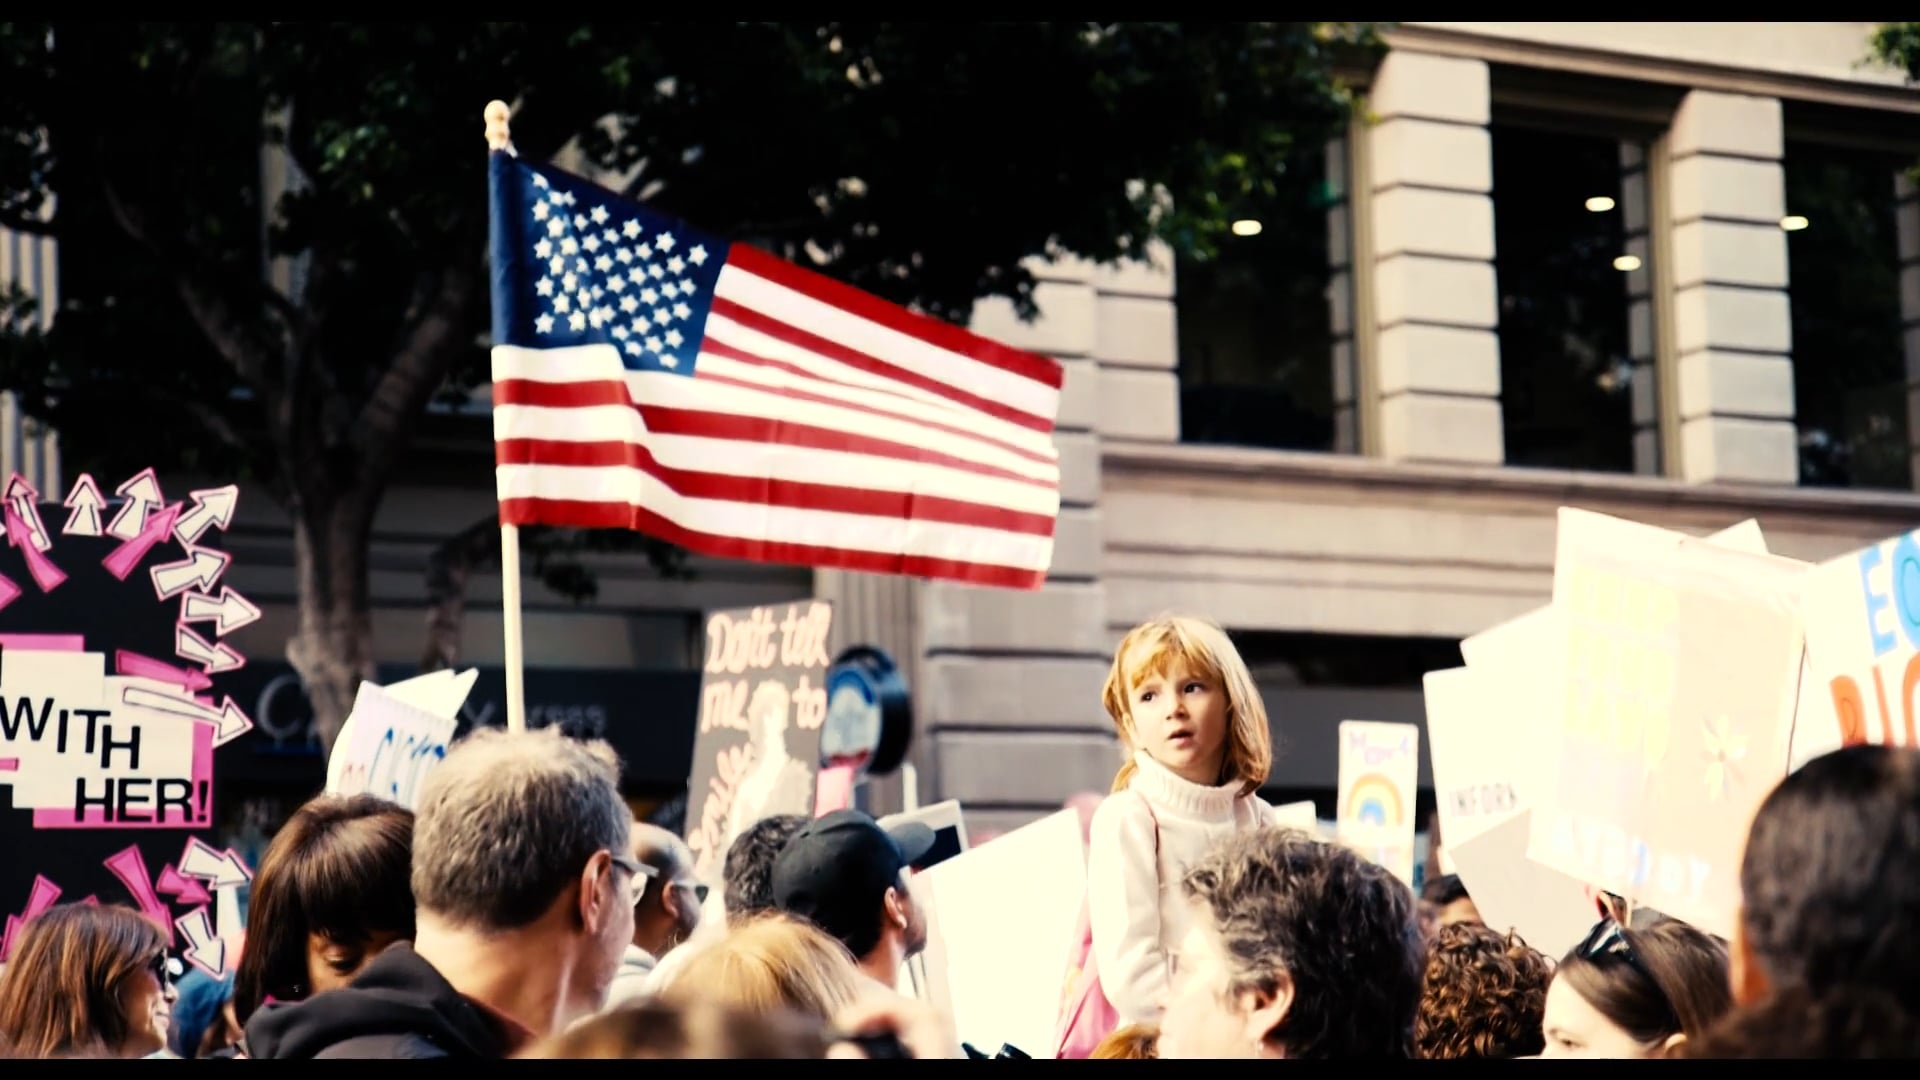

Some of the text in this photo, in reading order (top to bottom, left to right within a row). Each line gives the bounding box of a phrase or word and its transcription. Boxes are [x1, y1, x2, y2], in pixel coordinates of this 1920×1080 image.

[704, 601, 832, 674] Don't tell
[0, 696, 141, 770] WITH
[700, 674, 827, 734] me to
[74, 777, 208, 823] HER!
